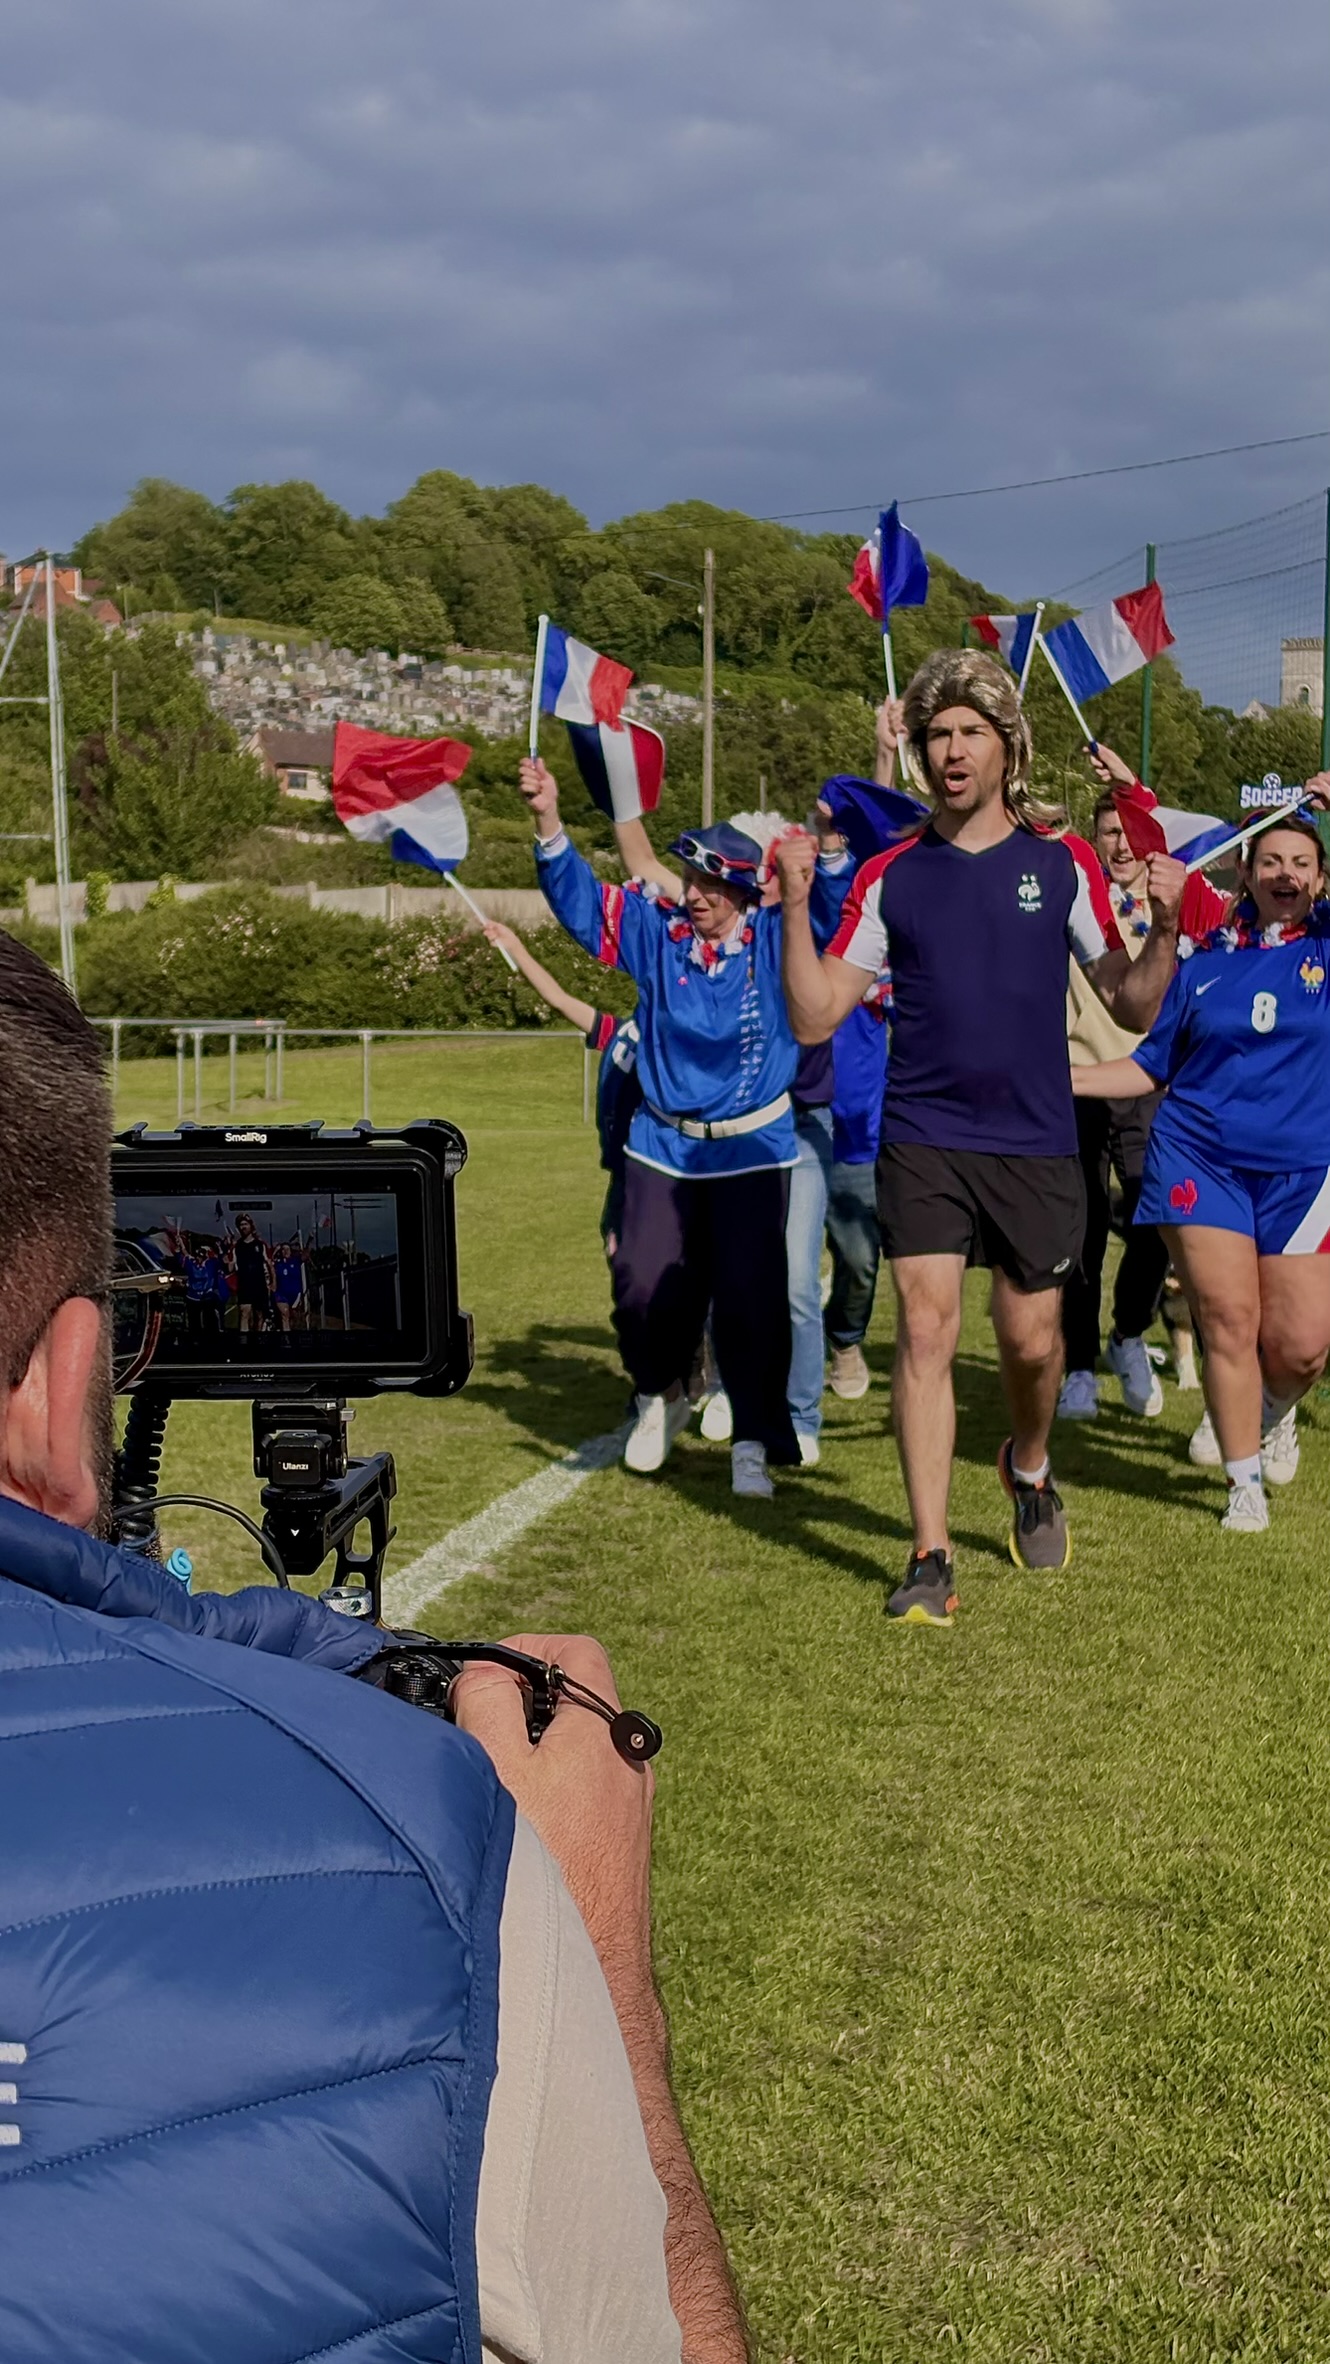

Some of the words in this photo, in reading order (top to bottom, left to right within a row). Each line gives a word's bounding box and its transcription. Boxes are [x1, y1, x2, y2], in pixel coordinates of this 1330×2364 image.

[1241, 785, 1303, 808] SOCCER
[1251, 991, 1277, 1034] 8
[225, 1132, 267, 1144] SmallRig
[282, 1462, 309, 1470] Ulanzi
